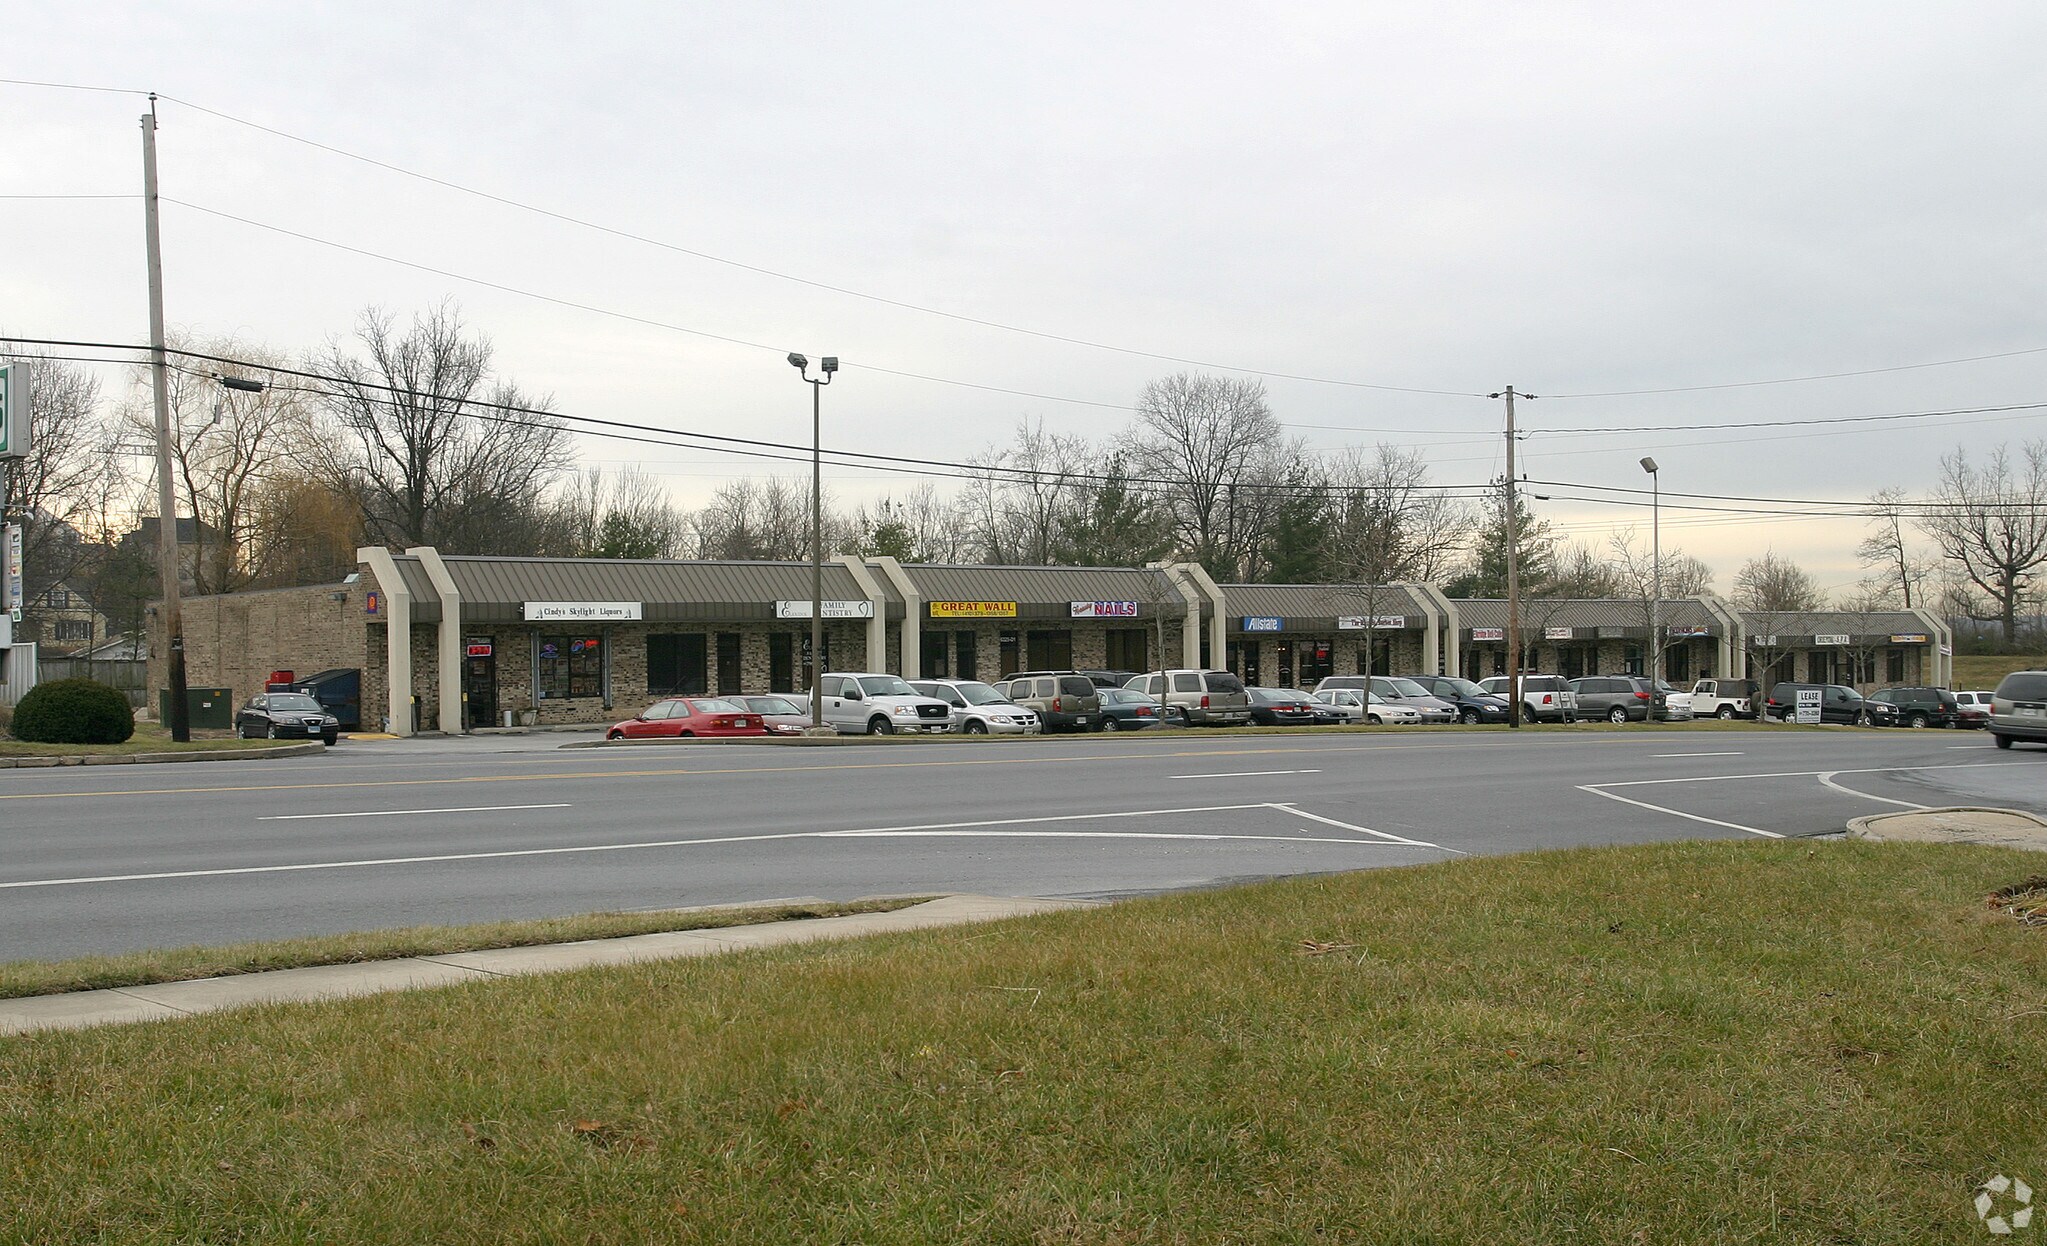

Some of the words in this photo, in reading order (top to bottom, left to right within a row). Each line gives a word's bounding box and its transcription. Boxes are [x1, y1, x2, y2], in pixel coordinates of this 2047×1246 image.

[821, 601, 847, 609] AMILY
[941, 602, 980, 611] GREAT
[984, 602, 1014, 611] WALL
[1094, 601, 1136, 616] NAILS
[569, 607, 596, 617] Skylight
[599, 608, 623, 617] Liquors
[821, 609, 854, 617] NTISTRY
[1248, 618, 1278, 630] Allstate
[1801, 692, 1818, 700] LEASE
